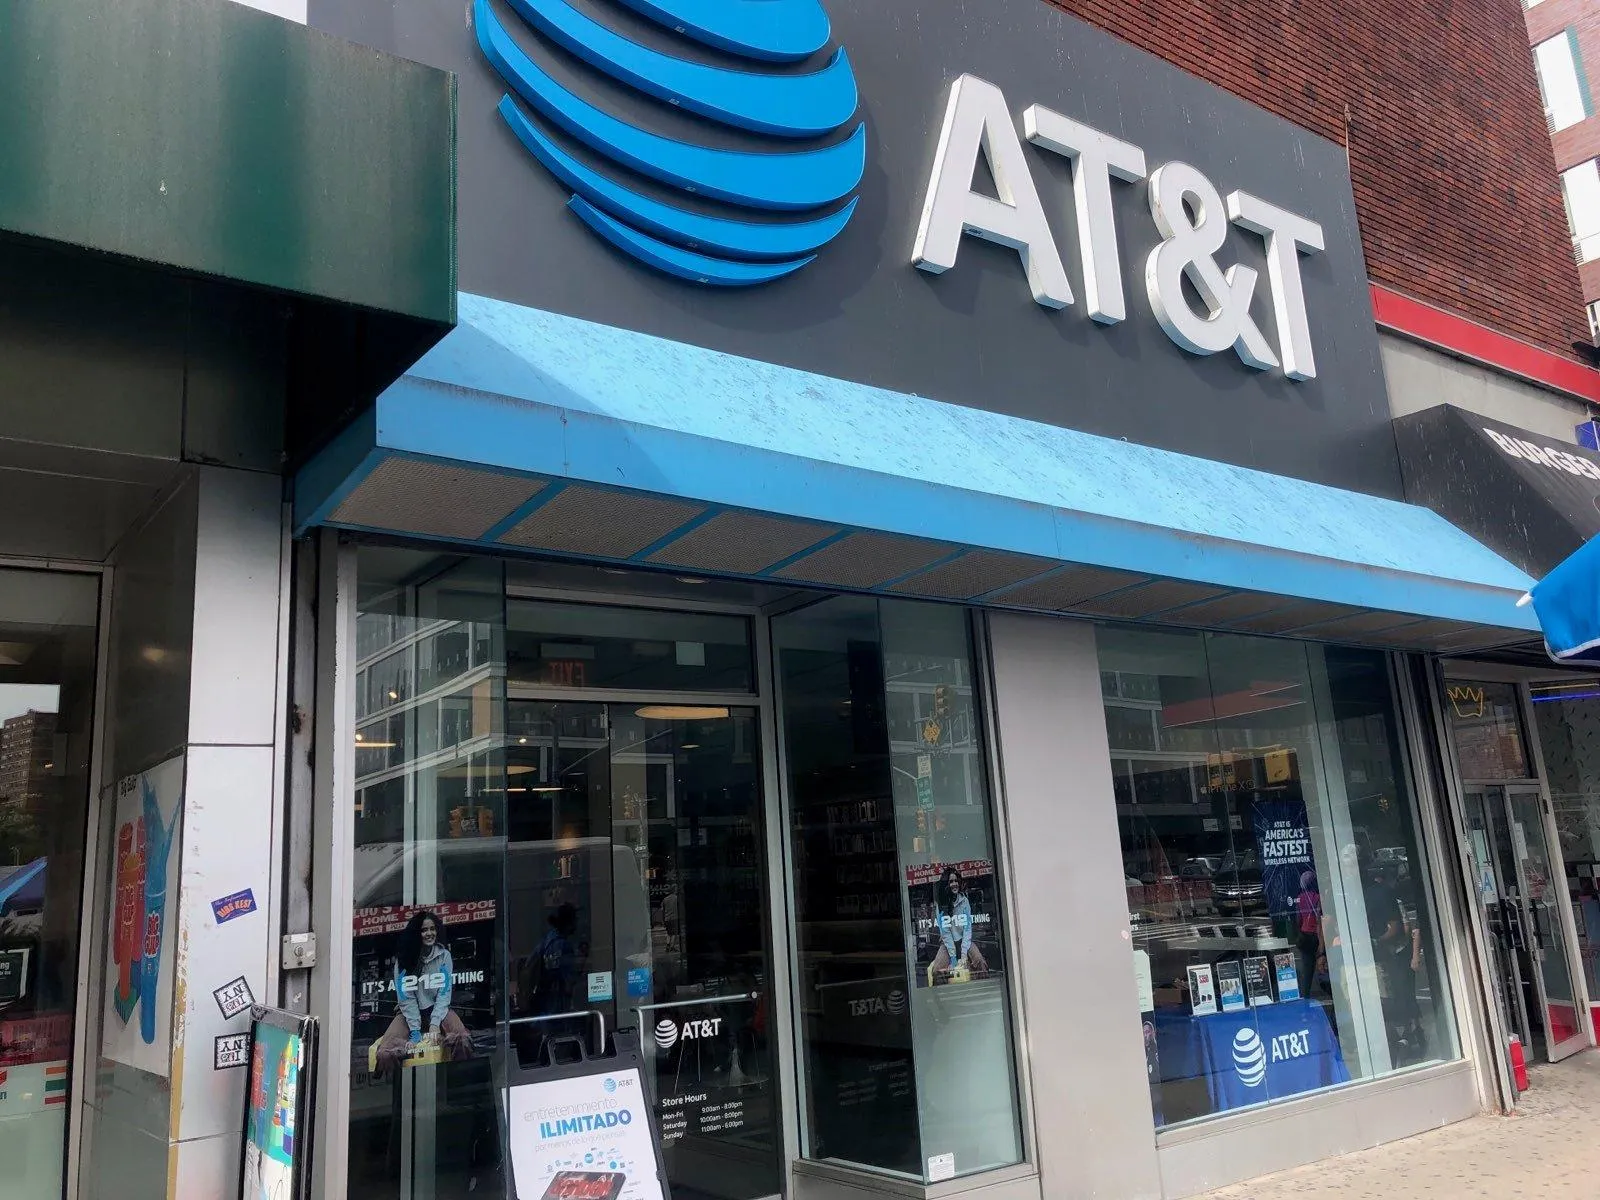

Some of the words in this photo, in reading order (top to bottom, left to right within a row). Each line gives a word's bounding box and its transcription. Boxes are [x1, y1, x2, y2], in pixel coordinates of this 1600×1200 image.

[911, 72, 1325, 382] AT&T
[1265, 828, 1304, 840] AMERICA'S
[1263, 839, 1309, 857] FASTEST
[1264, 857, 1287, 866] WIRELESS
[1287, 855, 1310, 864] NETWORK
[362, 914, 399, 926] HOME
[919, 919, 932, 929] IT'S
[970, 913, 991, 924] THING
[362, 981, 385, 995] IT'S
[387, 980, 396, 992] A
[451, 970, 484, 985] THING
[681, 1018, 722, 1040] AT&T
[1272, 1029, 1310, 1063] AT&T
[618, 1079, 634, 1087] AT&T
[662, 1097, 684, 1108] Store
[684, 1093, 707, 1104] Hours
[523, 1097, 618, 1123] entretenimiento
[662, 1110, 684, 1121] Mon-Fri
[539, 1109, 632, 1139] ILIMITADO
[662, 1120, 688, 1130] Saturday
[663, 1131, 684, 1141] Sunday
[701, 1123, 722, 1133] 11:00am
